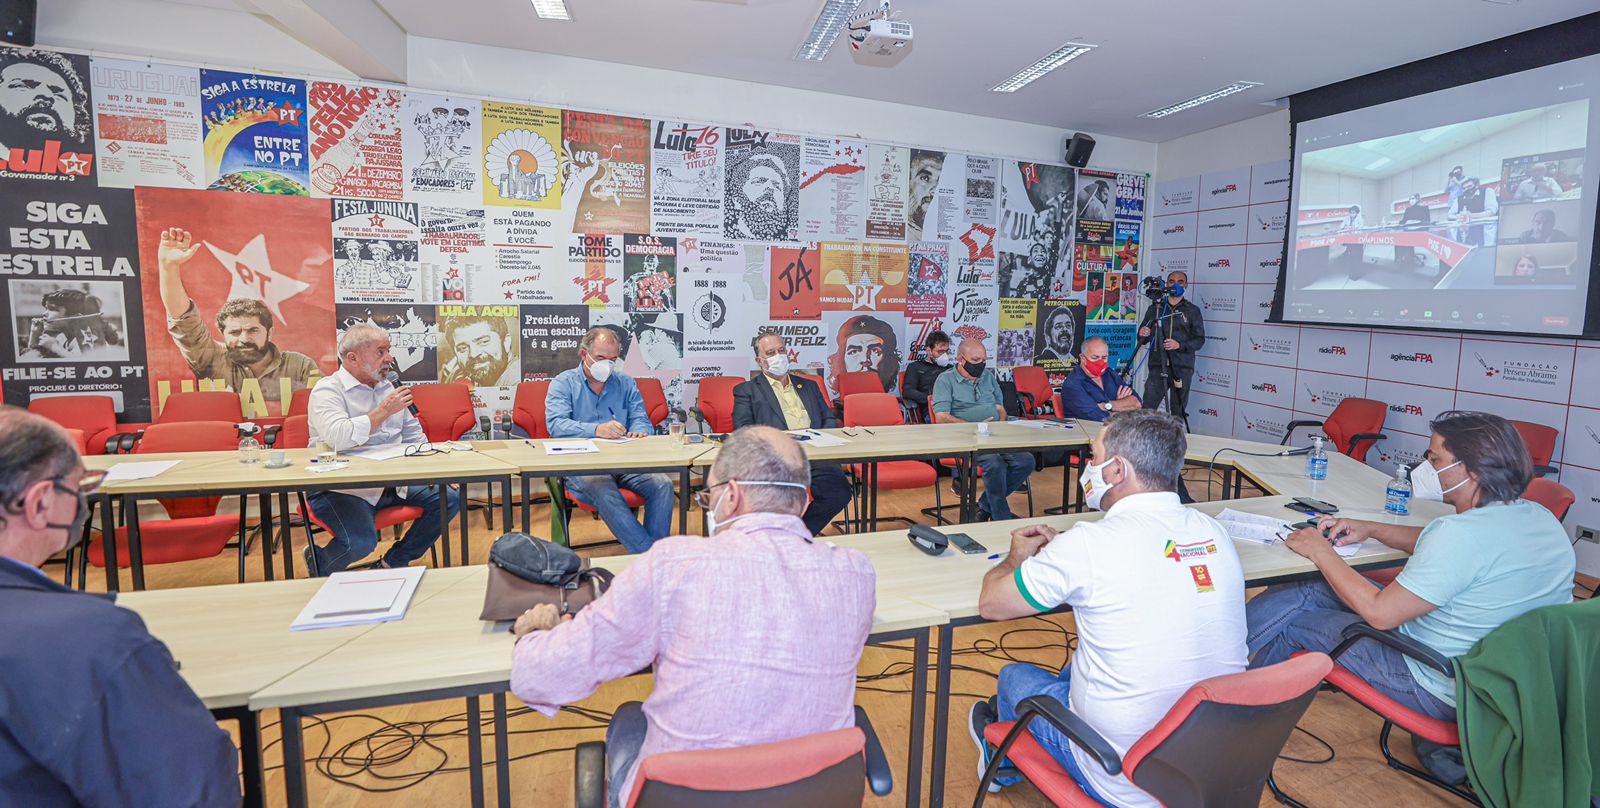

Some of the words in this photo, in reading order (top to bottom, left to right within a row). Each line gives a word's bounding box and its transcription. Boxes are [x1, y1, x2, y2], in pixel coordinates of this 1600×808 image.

[201, 84, 230, 101] SIGA
[243, 78, 296, 95] ESTRELA
[124, 94, 133, 102] 27
[146, 98, 167, 106] JUNHO
[279, 109, 295, 121] PT
[310, 85, 356, 136] FELIZ
[254, 135, 300, 150] ENTRE
[310, 123, 346, 160] ANO
[654, 121, 698, 152] Lula
[254, 150, 274, 163] NO
[279, 152, 302, 167] PT
[682, 150, 702, 162] TIRE
[702, 148, 720, 158] SEU
[68, 161, 83, 171] PT
[608, 161, 646, 170] ELEIÇÕES
[1, 171, 58, 181] Governador
[345, 166, 362, 178] 21
[366, 169, 402, 179] DEZEMBRO
[1025, 164, 1036, 181] PT
[416, 177, 456, 189] EDUCADORES
[460, 179, 474, 191] PT
[1116, 173, 1145, 188] GREVE
[1116, 185, 1144, 200] GERAL
[26, 200, 108, 225] SIGA
[334, 198, 370, 219] FESTA
[370, 201, 418, 225] JUNINA
[511, 210, 535, 218] QUEM
[446, 224, 466, 233] outra
[467, 222, 479, 230] vez
[493, 217, 513, 227] ESTÁ
[514, 219, 552, 228] PAGANDO
[1000, 209, 1037, 241] LULA
[512, 226, 538, 236] DÍVIDA
[9, 227, 91, 250] ESTA
[507, 236, 513, 245] É
[578, 236, 613, 247] TOME
[637, 236, 662, 246] S.O.S.
[520, 248, 541, 256] Salarial
[568, 246, 622, 258] PARTIDO
[625, 244, 676, 257] DEMOCRACIA
[699, 248, 715, 256] Uma
[715, 250, 739, 258] questão
[498, 259, 533, 267] Desemprego
[1076, 260, 1108, 272] CULTURA
[235, 261, 272, 299] PT
[778, 247, 814, 301] JÁ
[956, 265, 980, 284] Lula
[501, 278, 522, 288] FORA
[588, 280, 605, 294] PT
[694, 280, 709, 288] 1888
[712, 280, 727, 288] 1988
[854, 285, 875, 304] PT
[965, 298, 993, 308] ENCONTRO
[439, 305, 479, 317] LULA
[481, 305, 518, 318] AQUI
[964, 305, 990, 315] NACIONAL
[524, 314, 581, 326] Presidente
[521, 327, 549, 340] quem
[550, 325, 587, 338] escolhe
[784, 325, 819, 336] MEDO
[531, 339, 537, 348] é
[540, 341, 548, 349] a
[550, 339, 578, 352] gente
[1318, 344, 1347, 356] rádioFPA
[1390, 352, 1434, 364] agênciaFPA
[1503, 360, 1559, 370] FUNDAÇÃO
[2, 366, 76, 381] FILIE-SE
[84, 365, 113, 379] AO
[120, 365, 145, 378] PT
[1503, 367, 1527, 377] Perseu
[1527, 370, 1557, 381] Abramo
[29, 384, 68, 393] PROCURE
[1388, 404, 1423, 416] rádioFPA
[1164, 539, 1182, 562] 4
